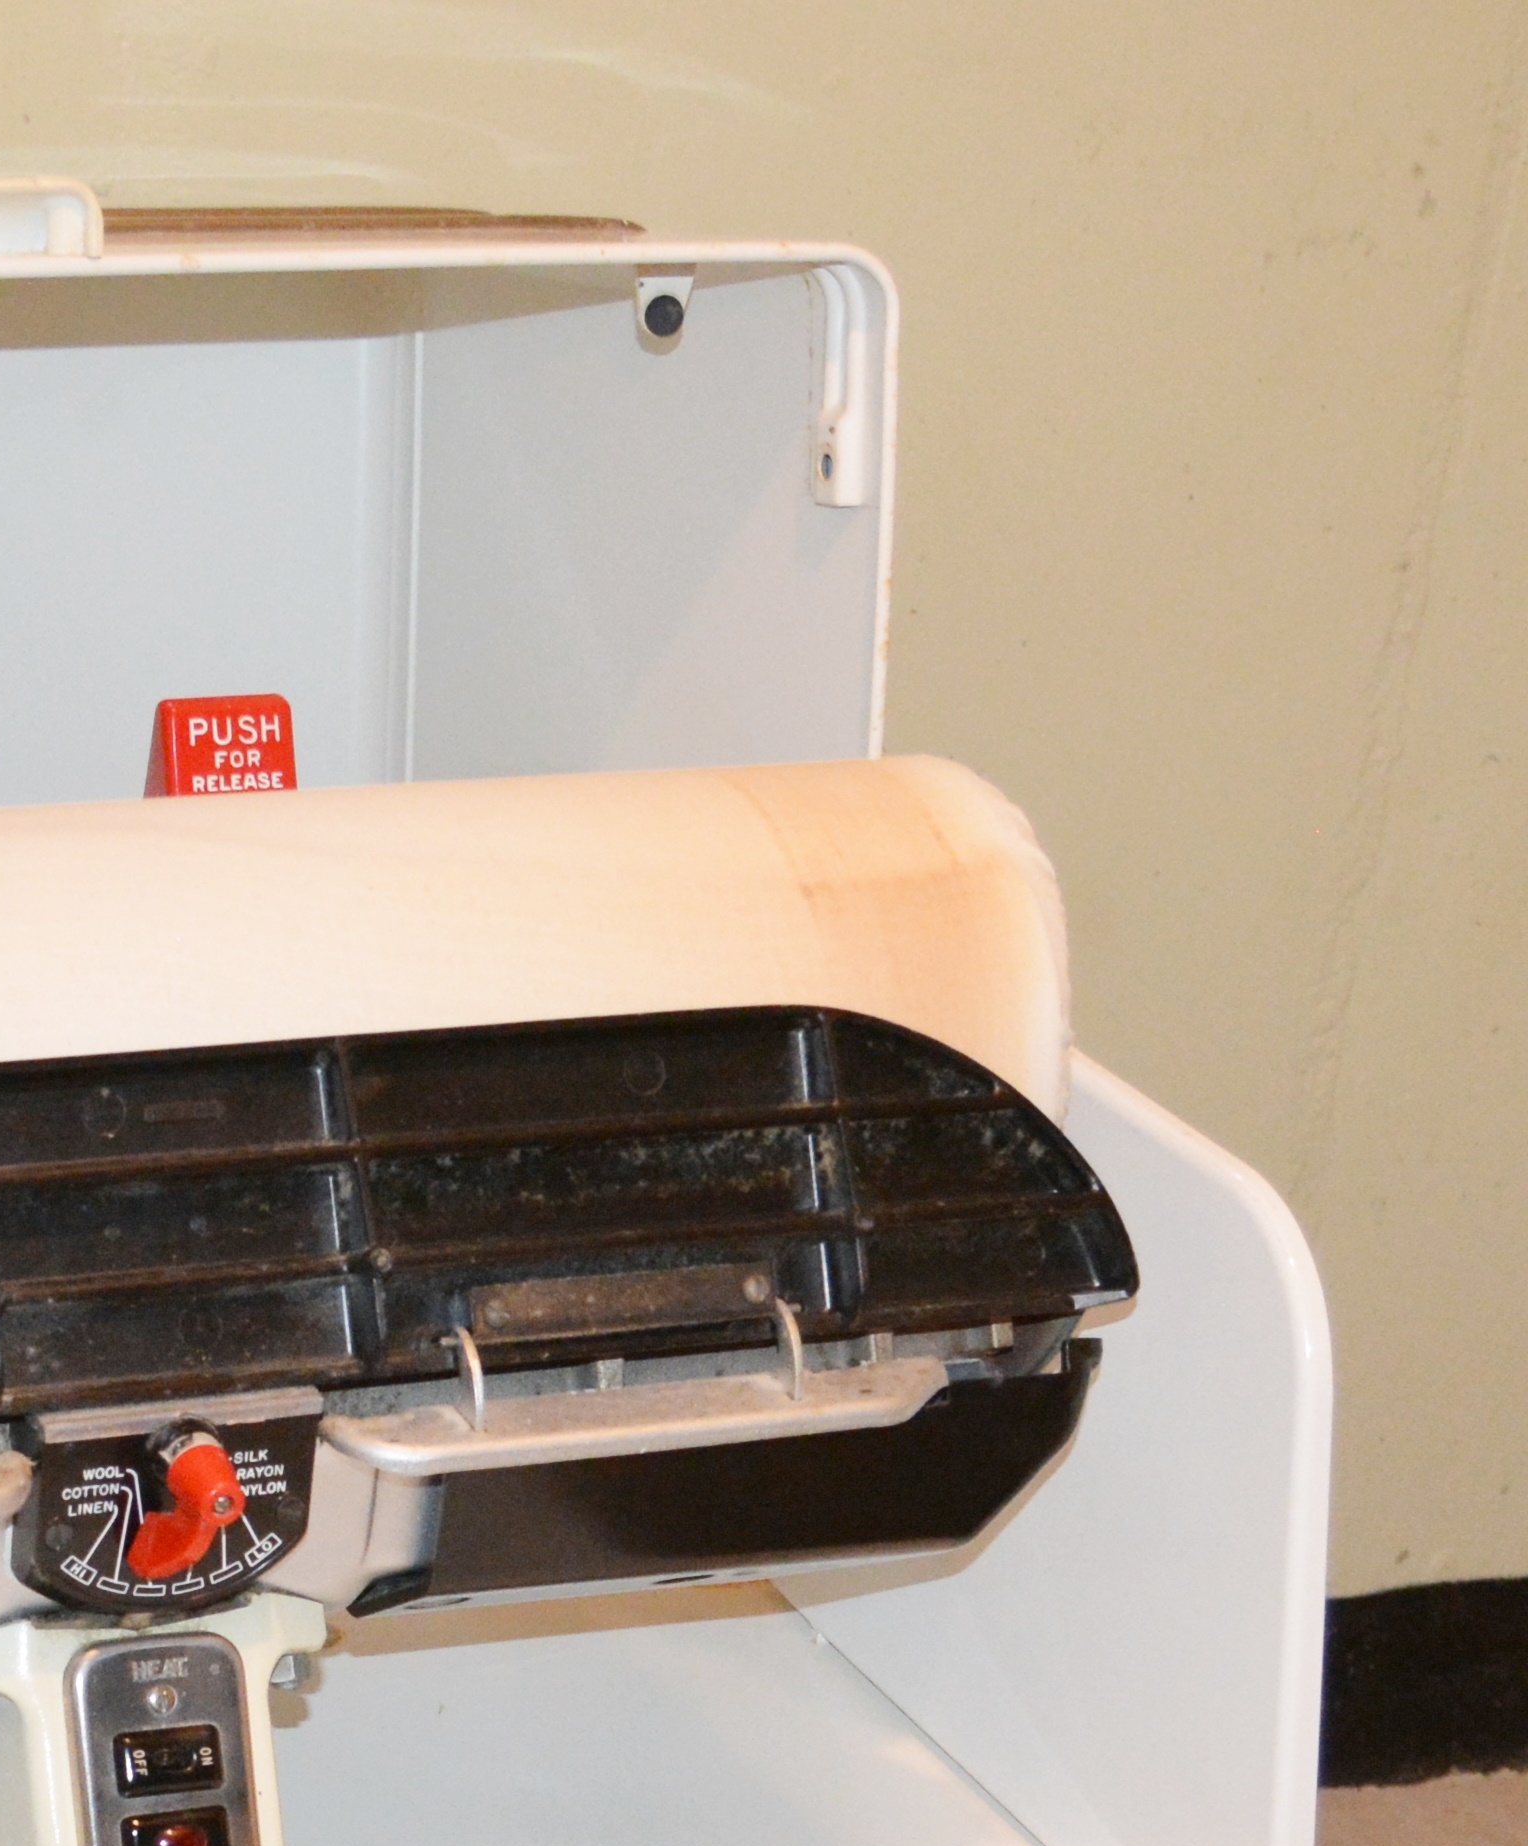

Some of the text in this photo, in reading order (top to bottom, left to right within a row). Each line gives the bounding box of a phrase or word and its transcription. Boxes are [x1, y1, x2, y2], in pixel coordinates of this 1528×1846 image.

[188, 714, 281, 747] PUSH
[214, 750, 262, 769] FOR
[192, 771, 284, 793] RELEASE
[233, 1449, 269, 1464] SILK
[83, 1466, 125, 1481] WOOL
[236, 1464, 285, 1481] RAYON
[62, 1483, 120, 1501] COTTON
[68, 1501, 114, 1517] LINEN
[253, 1541, 273, 1559] LO
[70, 1562, 88, 1580] HI
[131, 1657, 189, 1682] HEAT
[132, 1749, 149, 1777] OFF
[199, 1747, 214, 1767] ON
